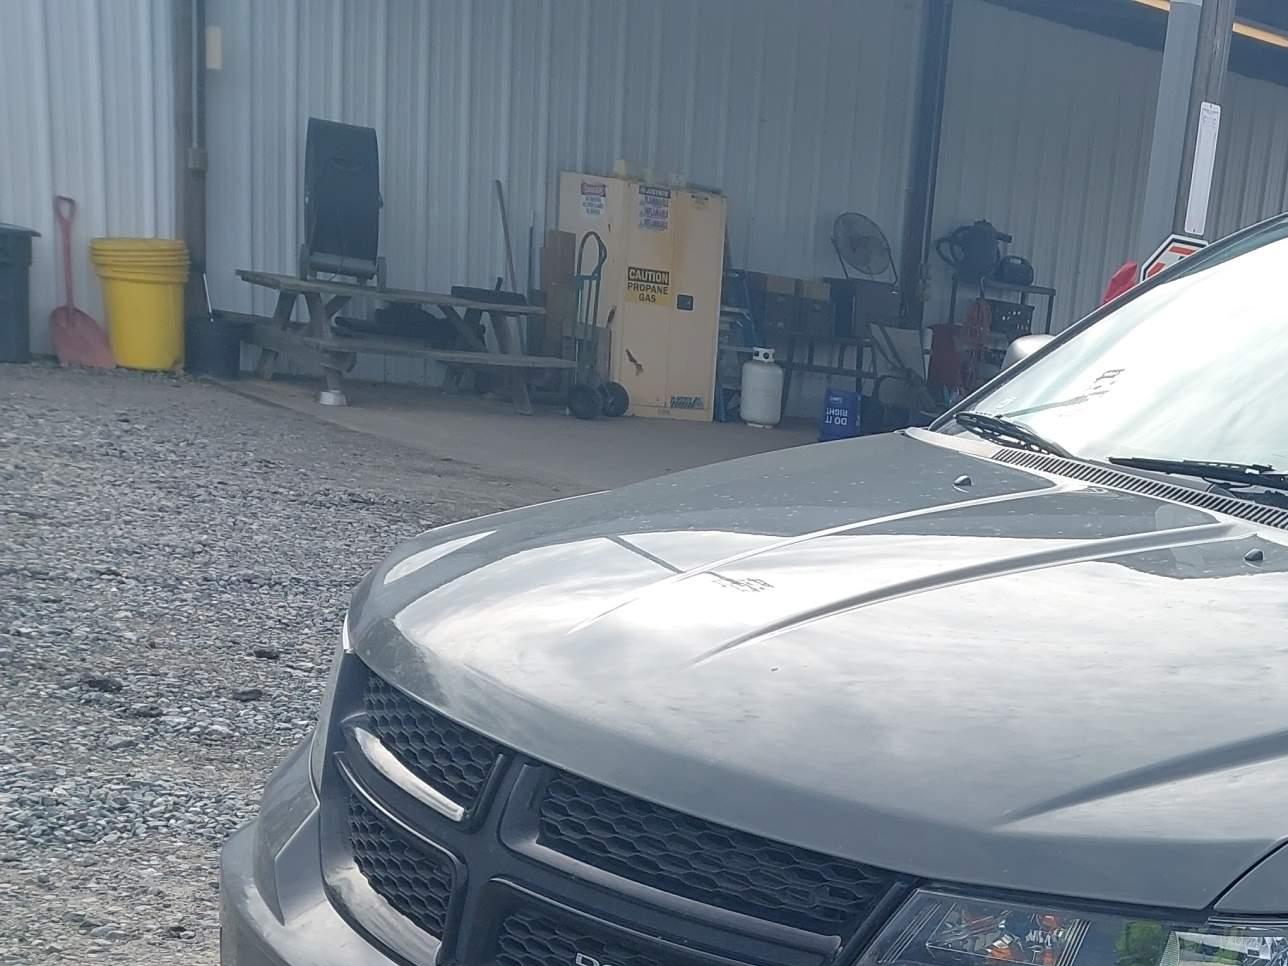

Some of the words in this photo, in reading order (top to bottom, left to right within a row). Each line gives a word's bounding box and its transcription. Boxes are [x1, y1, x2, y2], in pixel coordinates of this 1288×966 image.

[629, 268, 668, 284] CAUTION
[627, 282, 668, 295] PROPANE
[639, 293, 656, 303] GAS
[826, 407, 848, 417] RIGHT
[834, 416, 848, 426] DO
